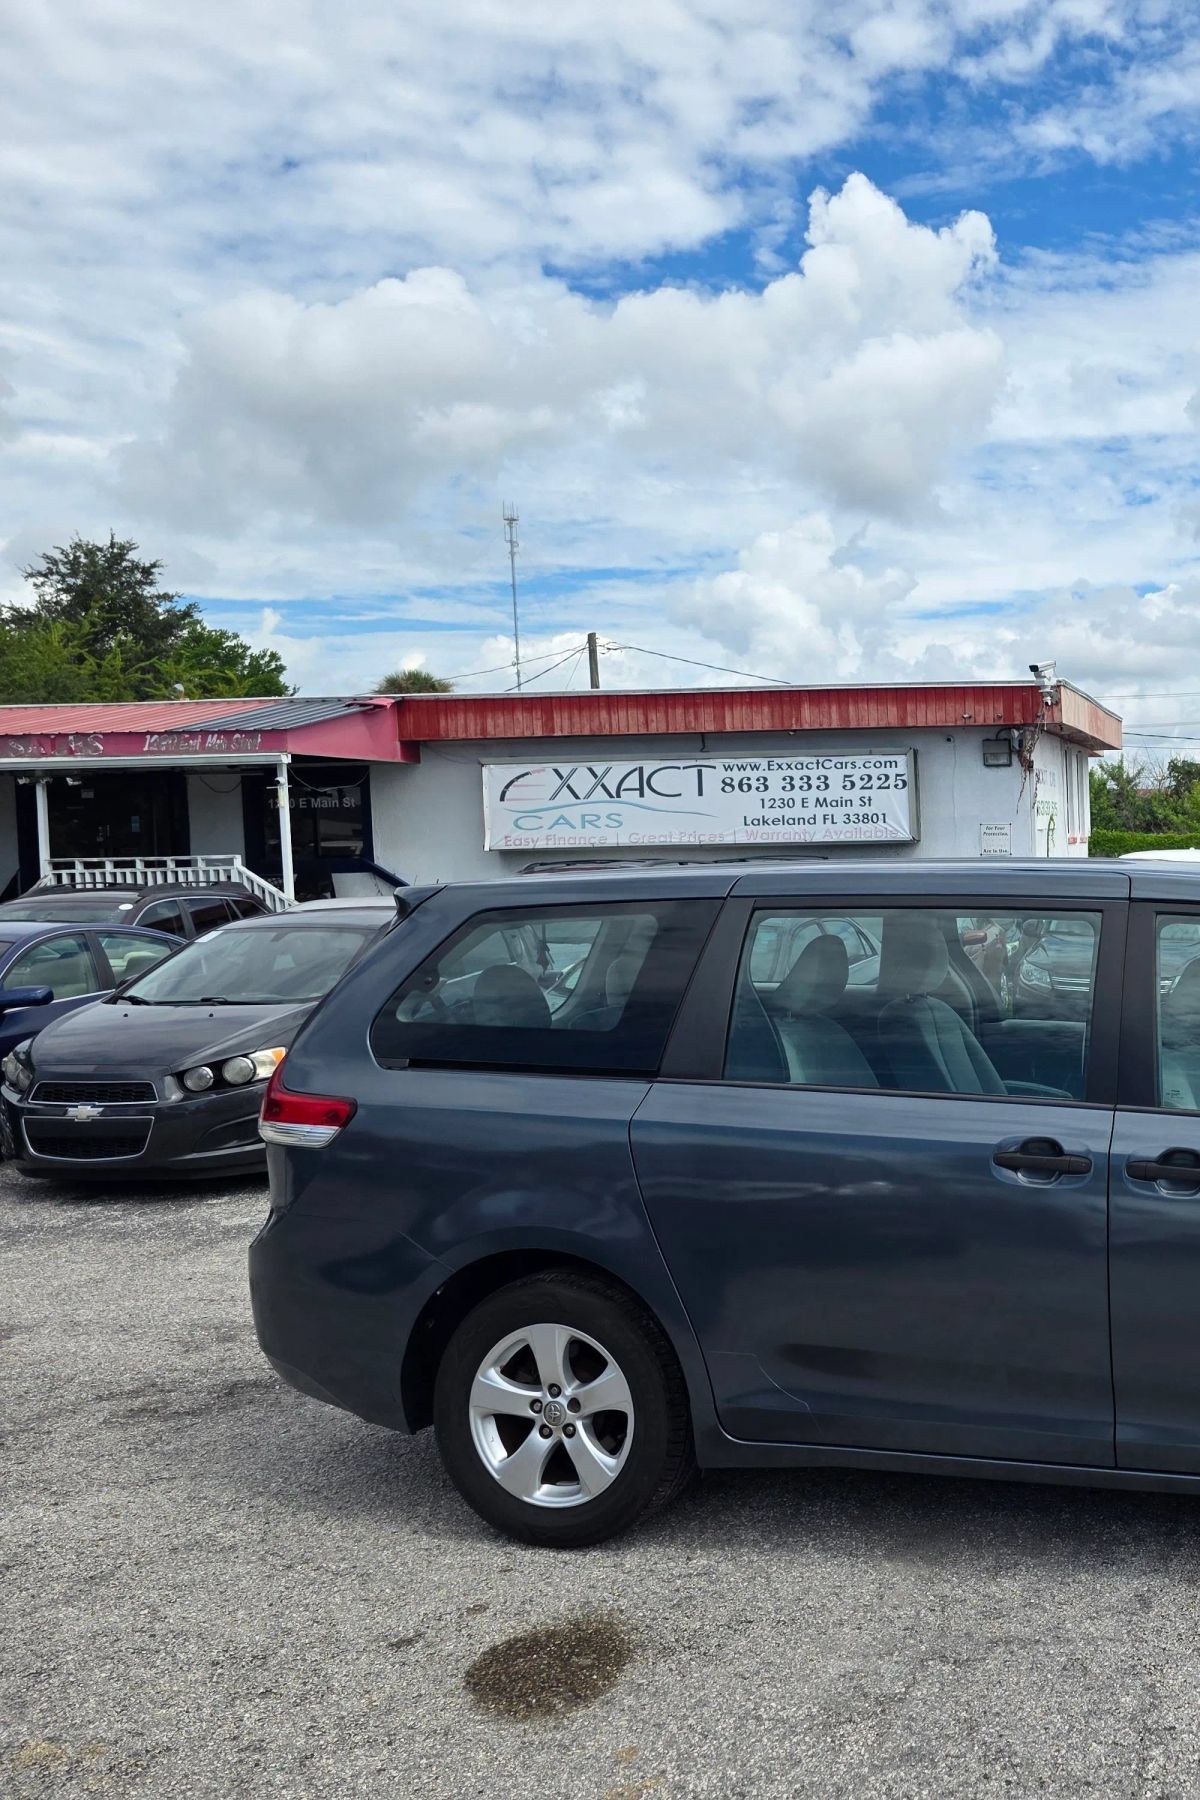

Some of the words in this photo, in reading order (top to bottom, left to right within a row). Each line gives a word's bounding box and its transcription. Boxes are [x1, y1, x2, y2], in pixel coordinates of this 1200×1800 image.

[723, 758, 898, 772] www.ExxactCars.com
[499, 765, 717, 802] EXXACT
[720, 776, 770, 793] 863
[781, 775, 830, 791] 333
[842, 773, 908, 790] 5225
[299, 798, 307, 808] E
[311, 797, 339, 808] Main
[343, 797, 355, 808] St
[760, 798, 796, 809] 1230
[801, 797, 809, 808] E
[814, 796, 854, 808] Main
[859, 796, 873, 807] St
[512, 813, 624, 831] CARS
[743, 814, 817, 826] Lakeland
[822, 814, 837, 825] FL
[843, 813, 887, 824] 33801
[504, 834, 540, 848] Easy
[545, 832, 608, 846] Finance
[628, 831, 673, 844] Great
[679, 829, 725, 843] Prices
[745, 828, 816, 842] Warranty
[823, 826, 898, 840] Available
